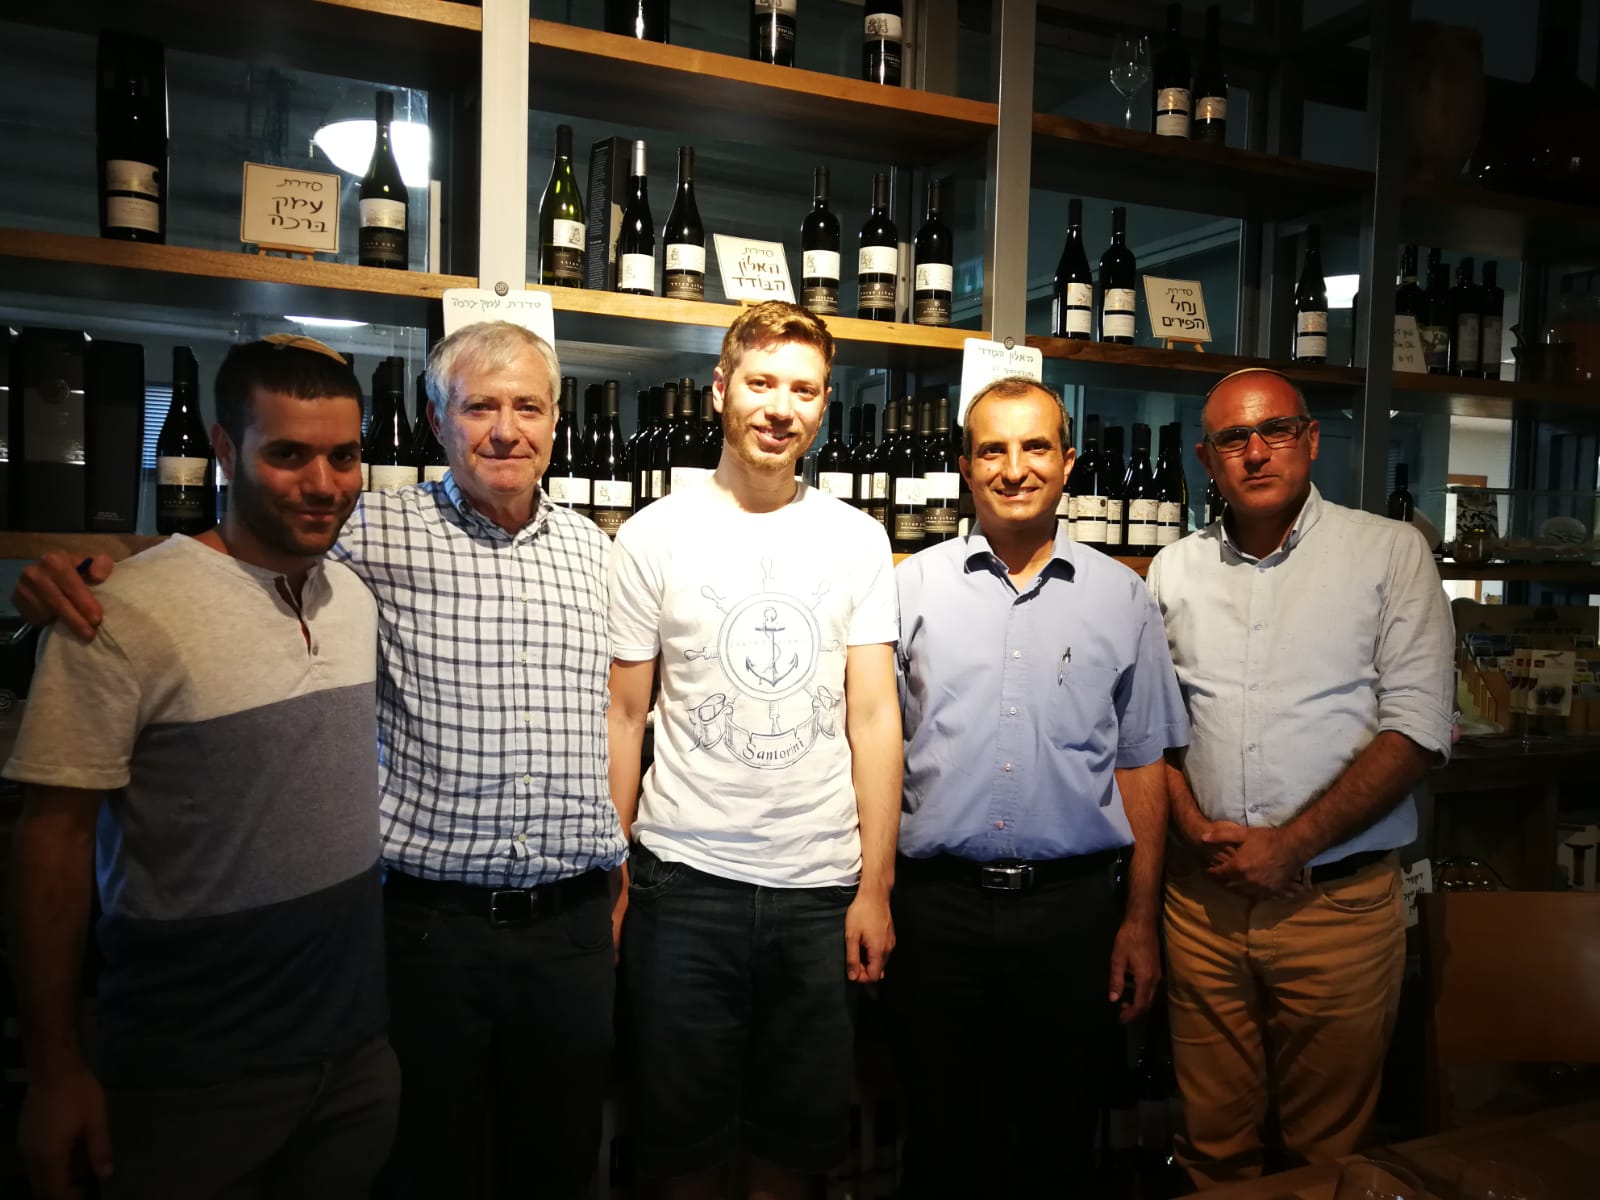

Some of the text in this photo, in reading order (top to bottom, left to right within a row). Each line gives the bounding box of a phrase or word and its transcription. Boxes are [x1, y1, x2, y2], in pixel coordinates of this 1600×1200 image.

[276, 179, 323, 192] סדרת
[271, 196, 324, 215] עמק
[741, 246, 775, 258] סדרת
[1164, 287, 1194, 297] סדרת
[1170, 294, 1197, 316] נחל
[742, 737, 804, 760] Santorini
